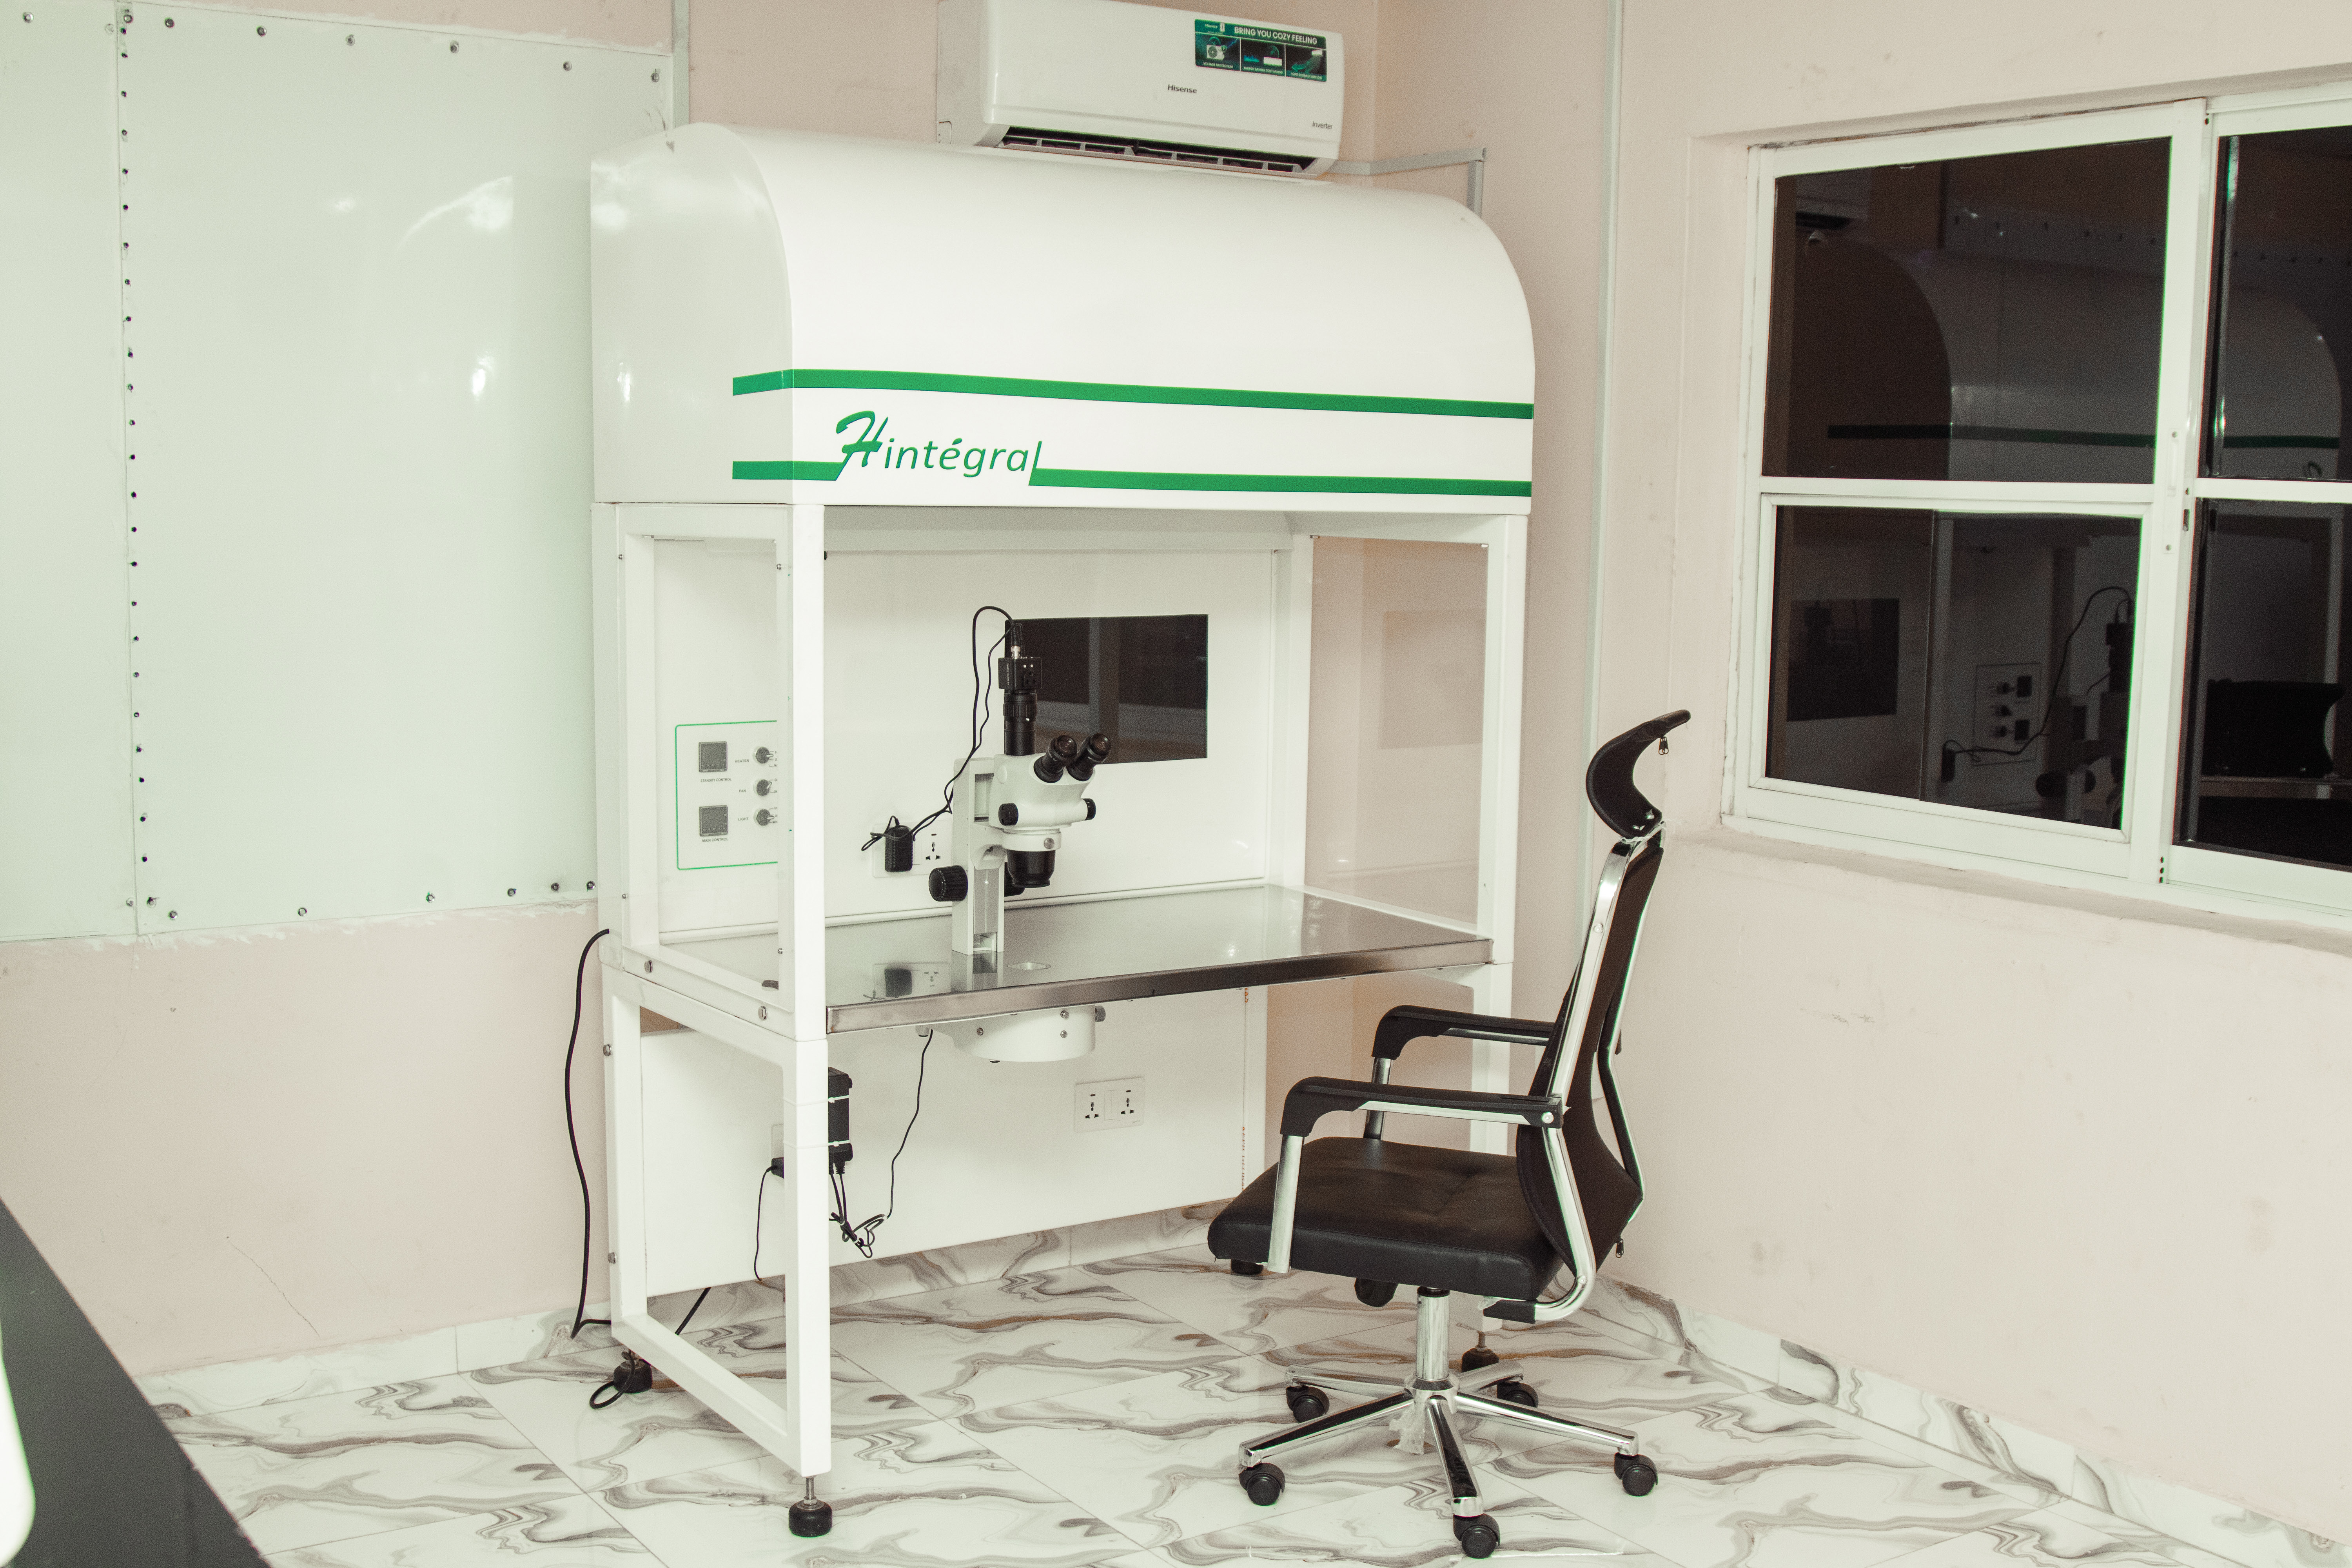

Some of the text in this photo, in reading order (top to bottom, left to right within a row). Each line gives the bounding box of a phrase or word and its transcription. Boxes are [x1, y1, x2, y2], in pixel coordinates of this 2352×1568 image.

[1234, 26, 1256, 36] BRING
[1272, 31, 1290, 41] COZY
[1292, 34, 1317, 44] FEELING
[1168, 84, 1197, 94] Hisense
[1312, 120, 1332, 129] Inverter
[836, 410, 1042, 485] Hintégral
